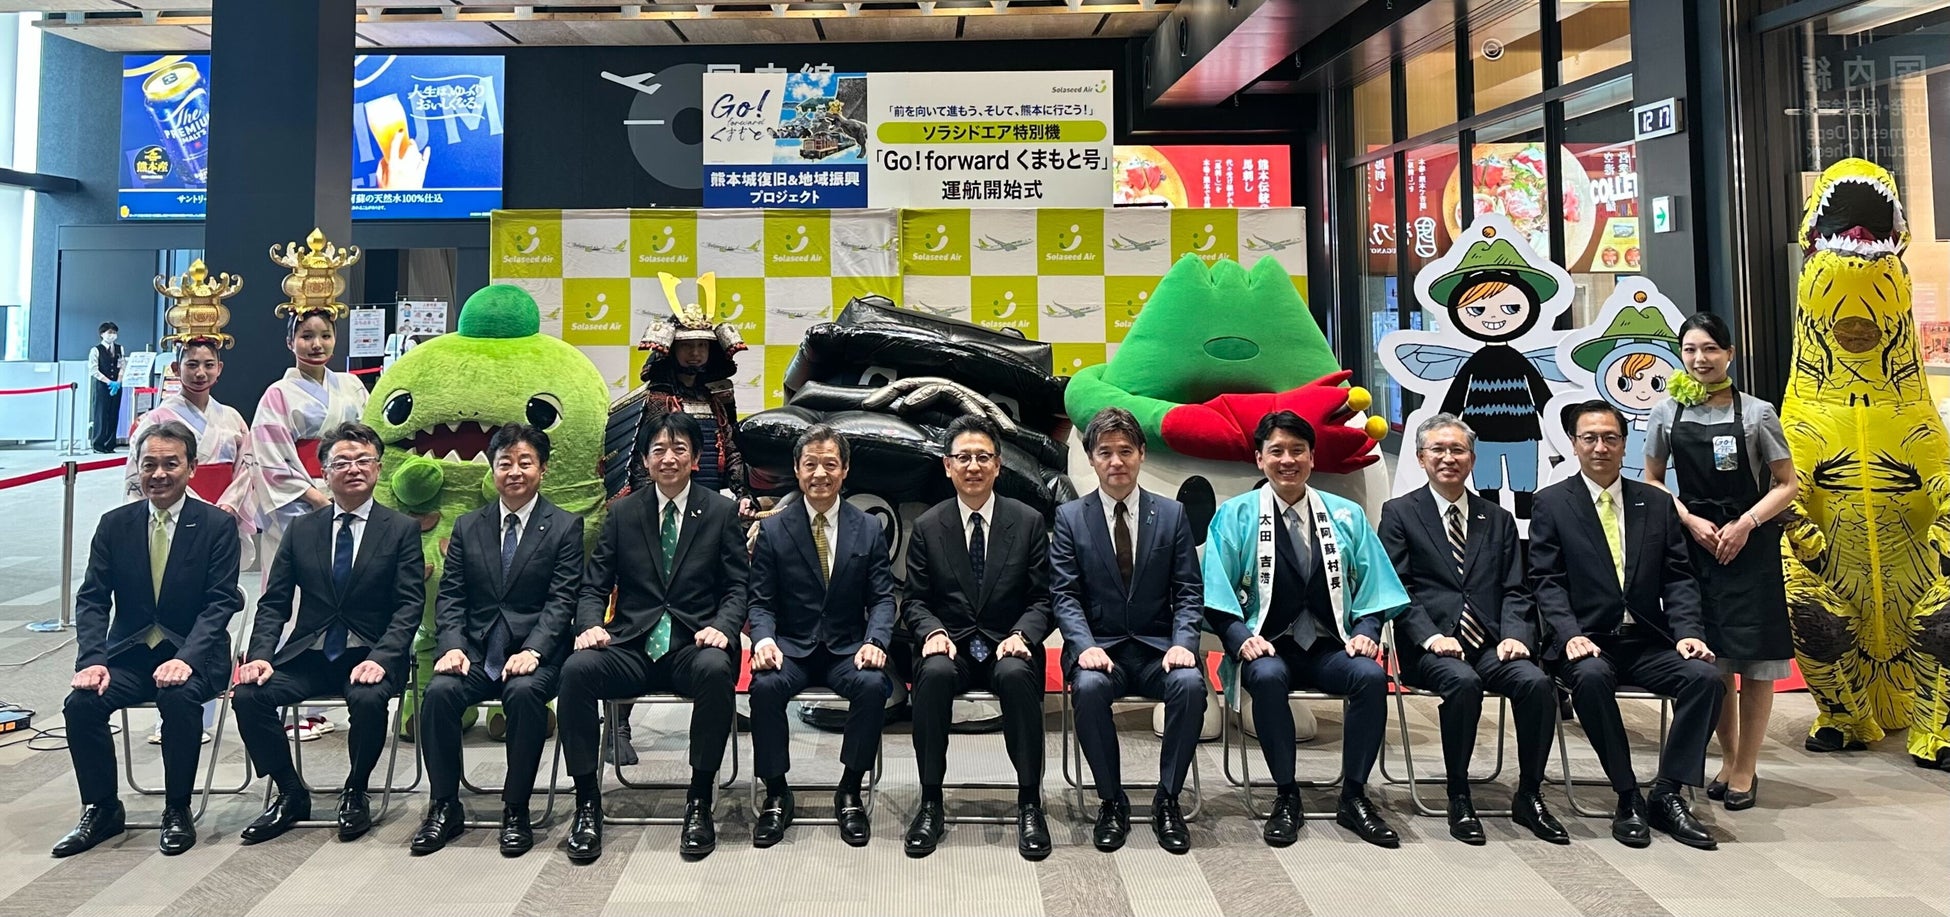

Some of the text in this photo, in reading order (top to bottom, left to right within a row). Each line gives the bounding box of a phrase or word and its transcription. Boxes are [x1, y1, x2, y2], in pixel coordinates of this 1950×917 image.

[1051, 85, 1093, 94] Solaseed Air
[710, 89, 771, 119] Go!
[1643, 106, 1669, 132] 12 17
[921, 124, 1061, 140] ソラシドエア特別機
[136, 160, 169, 173] 熊本産
[710, 171, 860, 187] 熊本城復旧&地域振興
[941, 180, 1043, 200] 運航開始式
[749, 190, 820, 205] プロジェクト
[503, 255, 554, 264] Solaseed Air
[639, 254, 689, 263] Solaseed Air
[772, 254, 823, 263] Solaseed Air
[912, 253, 962, 261] Solaseed Air
[1045, 252, 1096, 261] Solaseed Air
[571, 322, 622, 331] Solaseed Air
[744, 322, 757, 330] Air
[981, 320, 1030, 328] Solaseed Air
[1259, 514, 1272, 542] 太田
[1316, 512, 1341, 590] 南阿蘇村長
